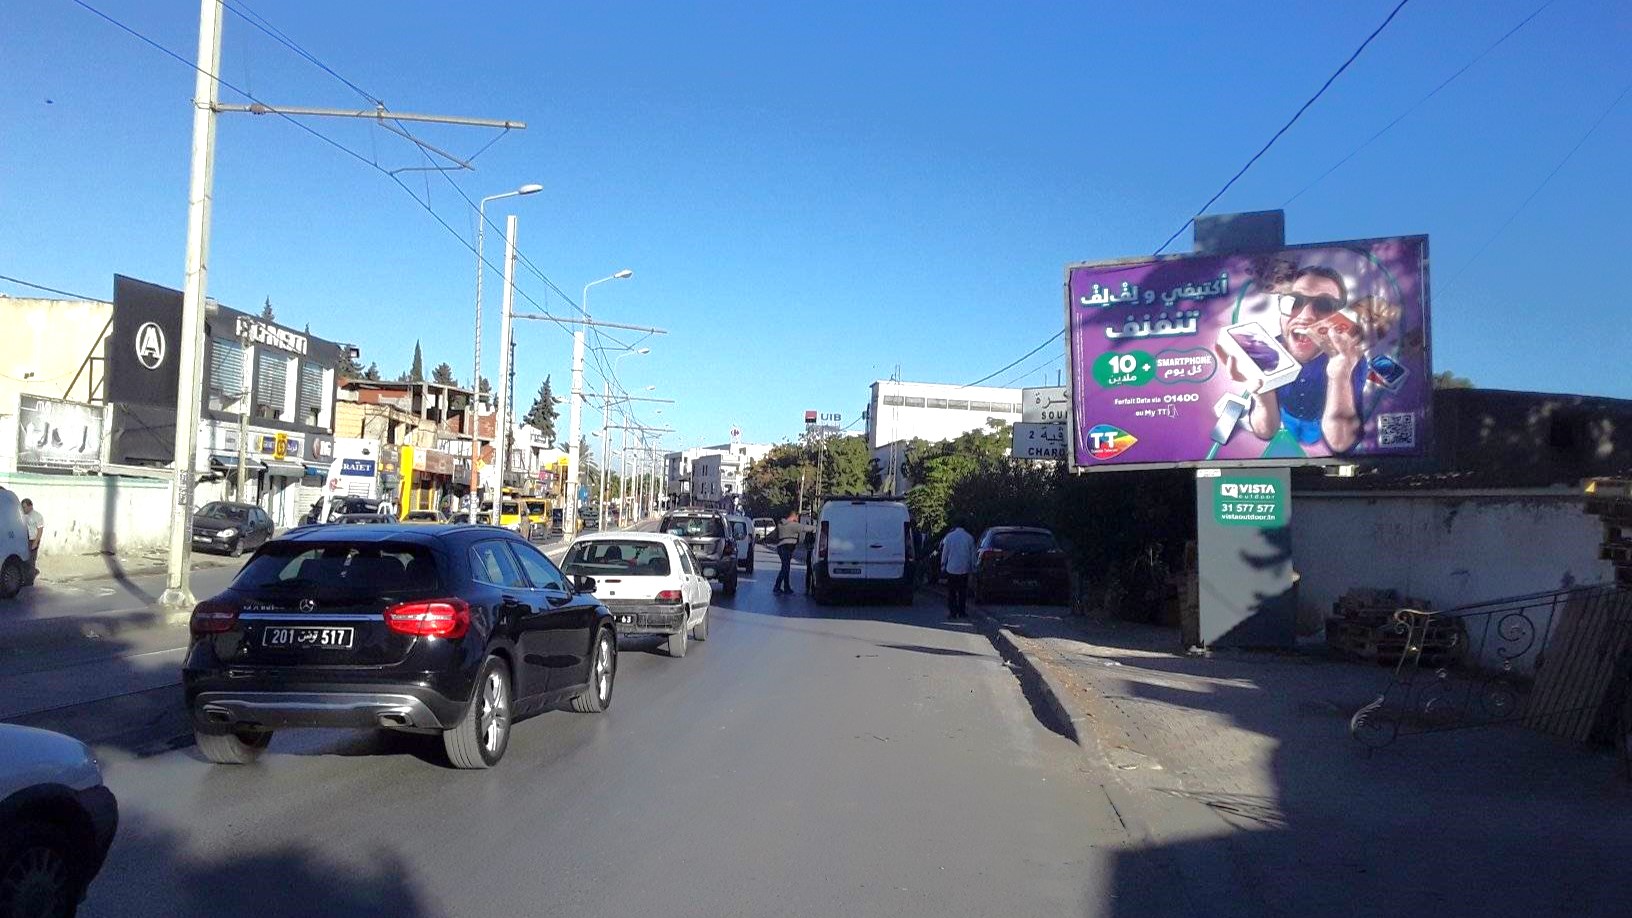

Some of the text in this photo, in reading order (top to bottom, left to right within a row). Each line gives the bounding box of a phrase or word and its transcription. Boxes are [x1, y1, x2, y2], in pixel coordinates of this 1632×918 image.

[1108, 354, 1137, 374] 10
[1157, 355, 1213, 367] SMARTPHONE
[1164, 364, 1203, 379] كل يوم
[1114, 396, 1136, 405] Forfait
[1136, 396, 1151, 404] Data
[1163, 393, 1200, 403] 01400
[821, 413, 842, 421] UIB
[1144, 408, 1156, 417] My
[1028, 430, 1035, 440] 2
[1090, 431, 1119, 449] TT
[1239, 484, 1276, 494] VISTA
[1221, 503, 1276, 513] 31 577 577
[621, 615, 632, 624] 63
[270, 629, 345, 645] 201 تونس 517
